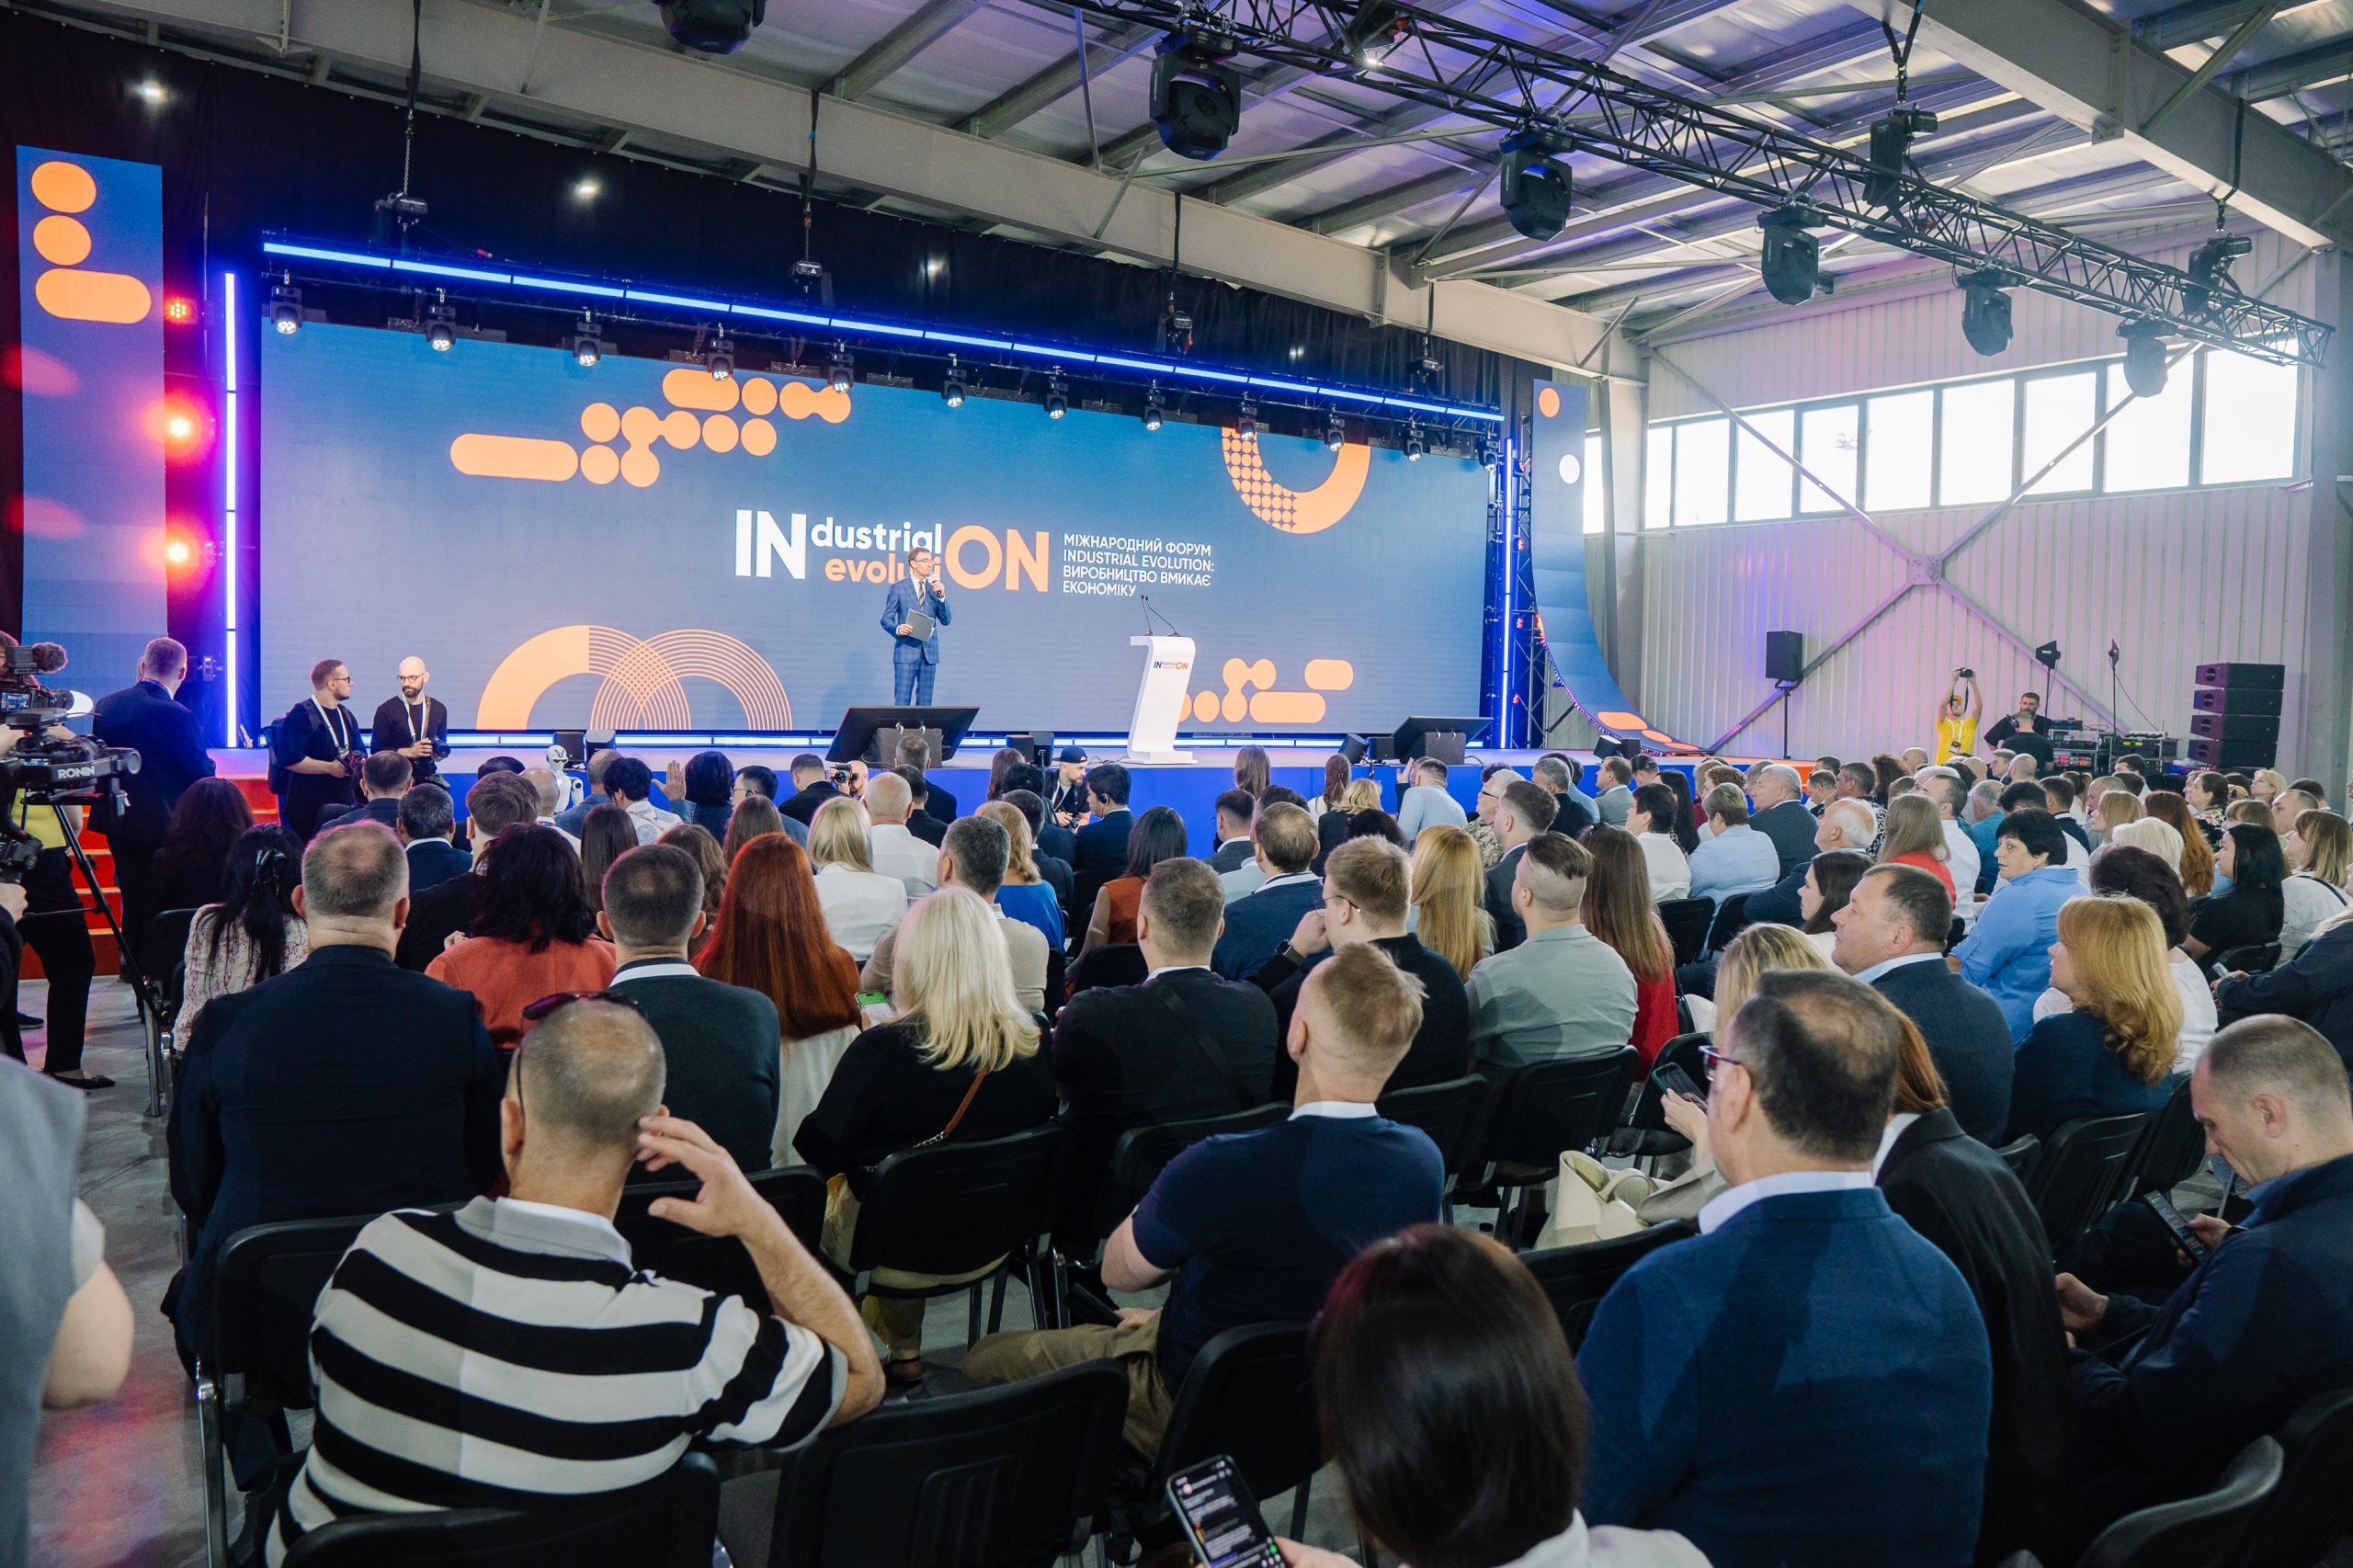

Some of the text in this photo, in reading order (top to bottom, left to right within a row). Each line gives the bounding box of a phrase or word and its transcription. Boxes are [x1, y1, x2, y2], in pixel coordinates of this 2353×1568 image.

[735, 509, 806, 579] IN
[1063, 533, 1211, 556] МІЖНАРОДНИЙ ФОРУМ
[945, 525, 1050, 593] ON
[1063, 550, 1214, 572] INDUSTRIAL EVOLUTION:
[1063, 565, 1211, 586] ВИРОБНИЦТВО ВМИКАЄ
[1063, 580, 1137, 597] ЕКОНОМІКУ
[57, 766, 96, 779] RONIN
